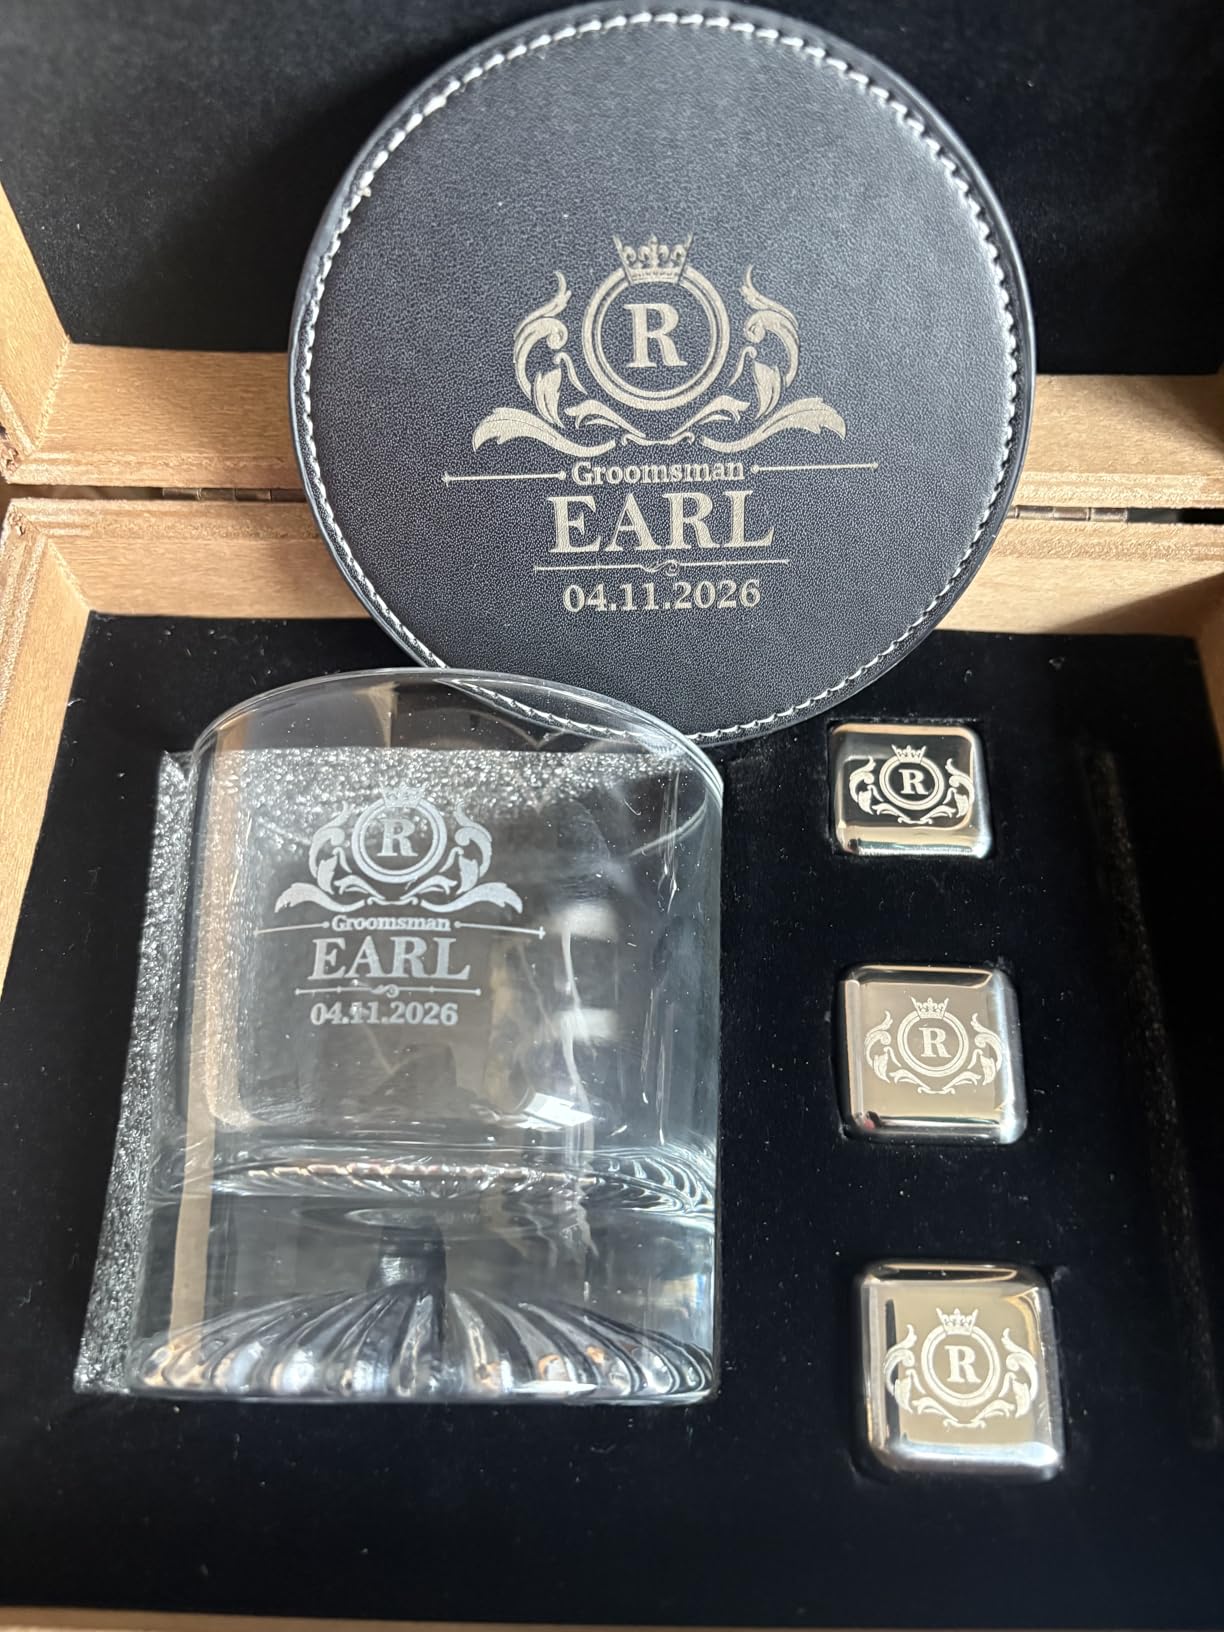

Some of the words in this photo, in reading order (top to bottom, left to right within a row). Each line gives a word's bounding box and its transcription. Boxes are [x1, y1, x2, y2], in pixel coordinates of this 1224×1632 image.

[623, 302, 687, 369] R
[571, 461, 746, 486] Groomsman
[546, 489, 775, 555] EARL
[562, 578, 762, 613] 04.11.2026
[899, 768, 929, 796] R
[377, 818, 418, 857] R
[331, 914, 452, 932] Groomsman
[307, 935, 471, 981] EARL
[310, 1001, 459, 1026] 04.11.2026
[919, 1026, 952, 1058] R
[943, 1345, 981, 1383] R
